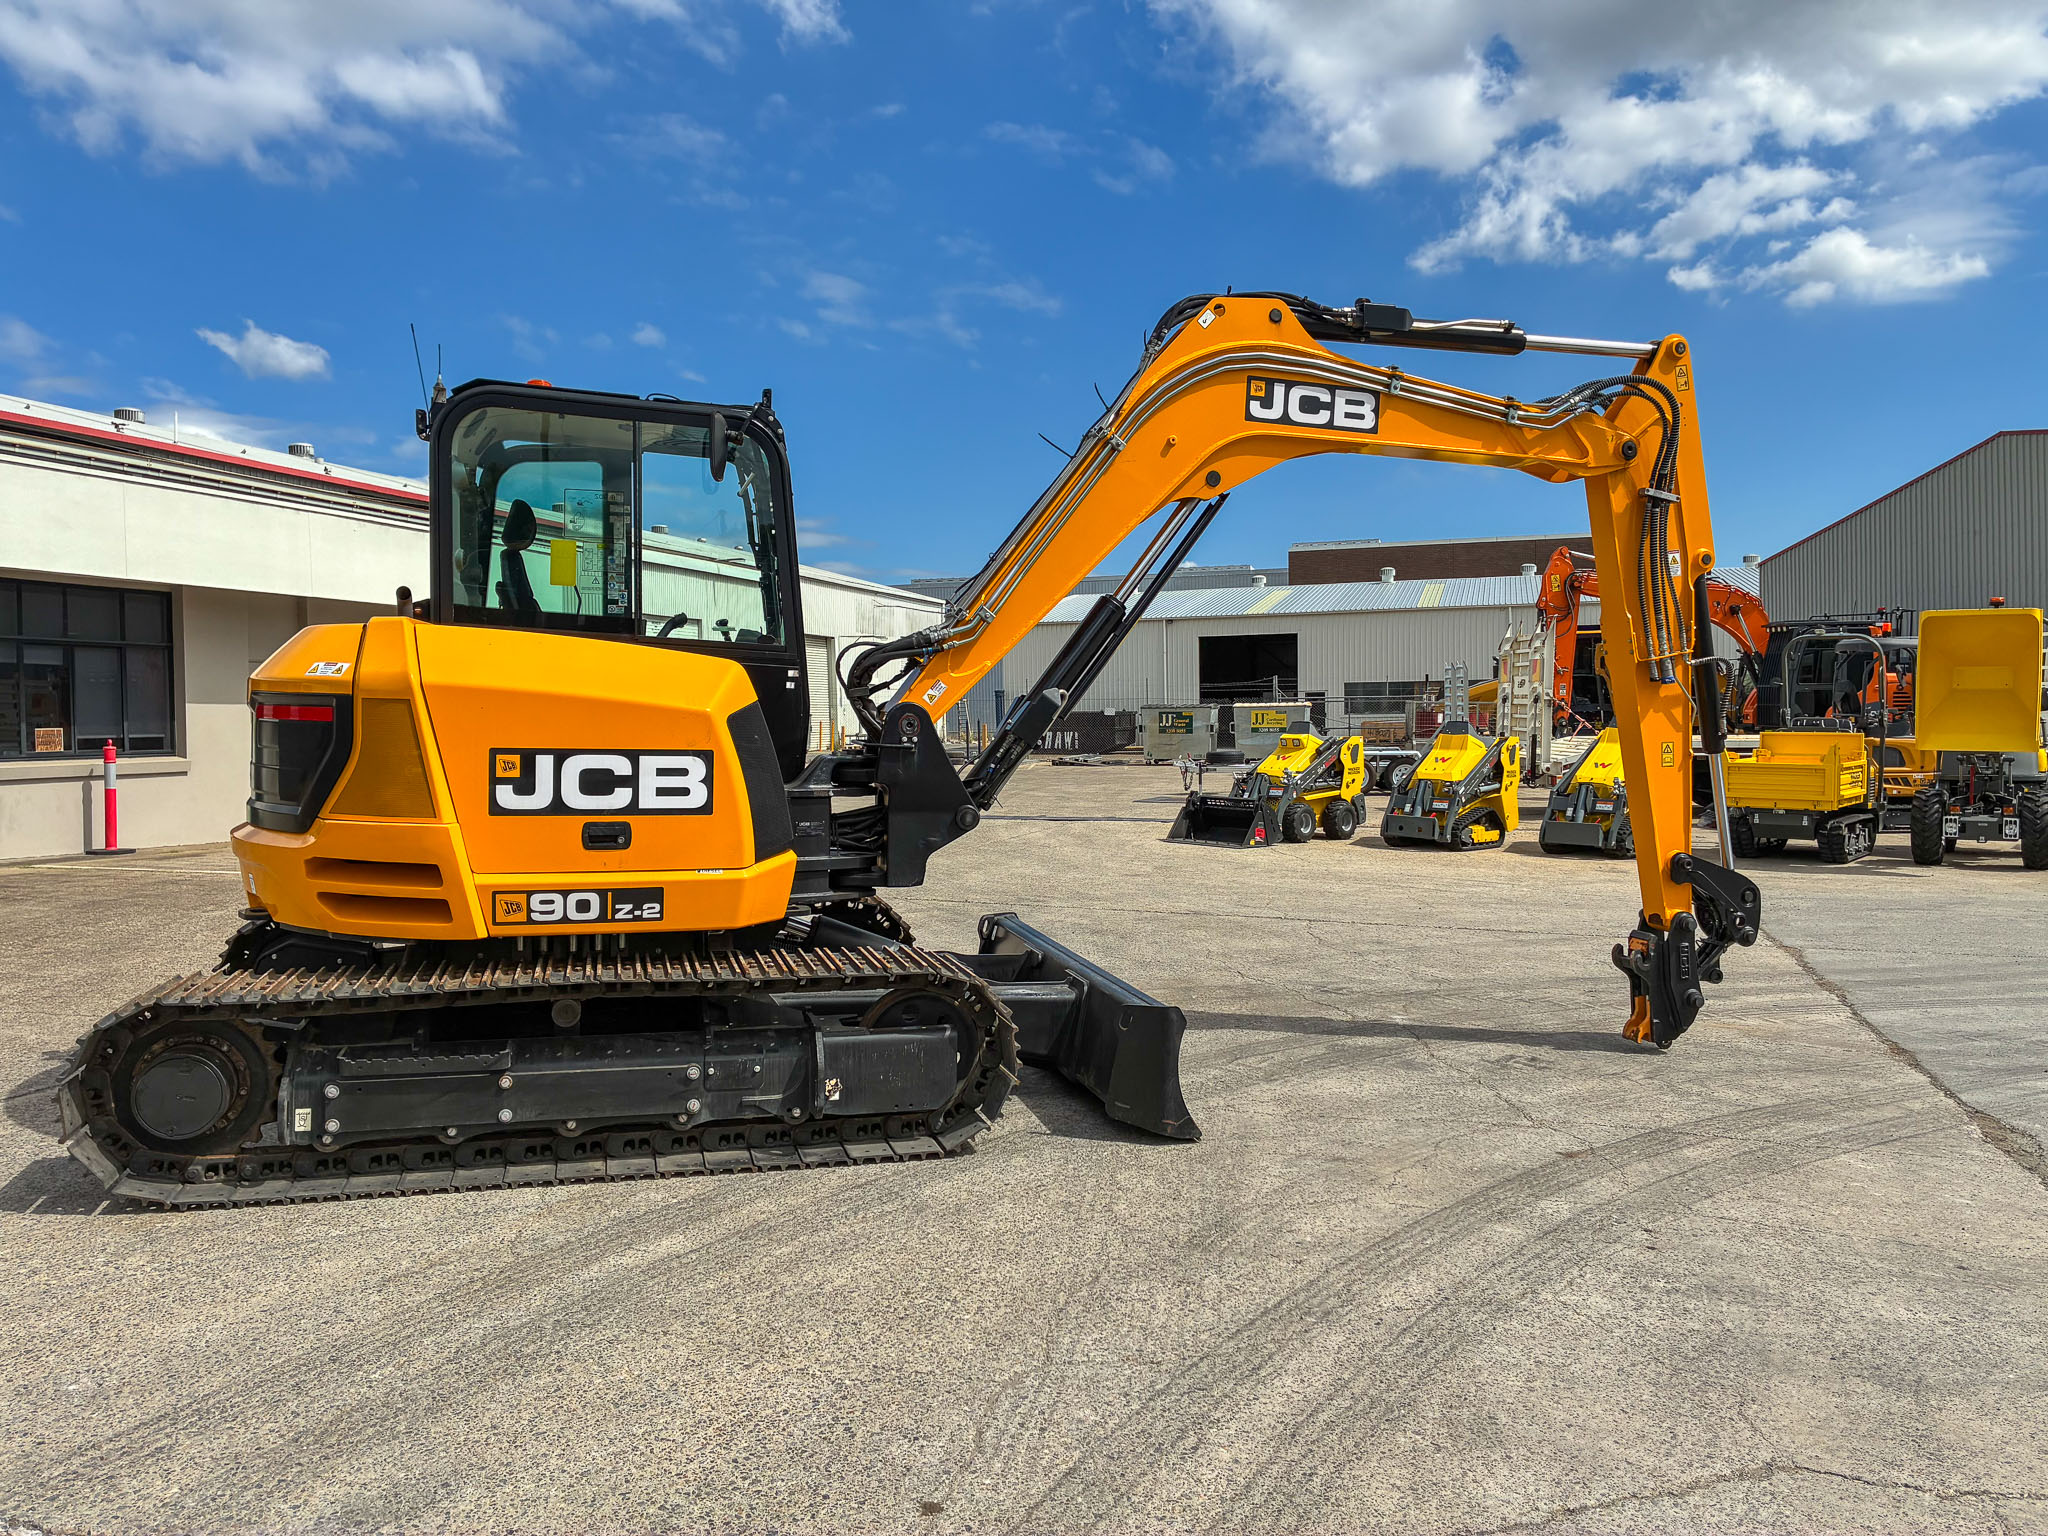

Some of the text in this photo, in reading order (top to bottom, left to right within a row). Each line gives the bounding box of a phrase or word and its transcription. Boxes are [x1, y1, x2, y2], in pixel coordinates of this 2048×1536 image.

[1250, 382, 1376, 429] JCB
[496, 755, 708, 810] JCB
[500, 759, 517, 772] JCB
[500, 892, 661, 921] JCB 90 Z-2
